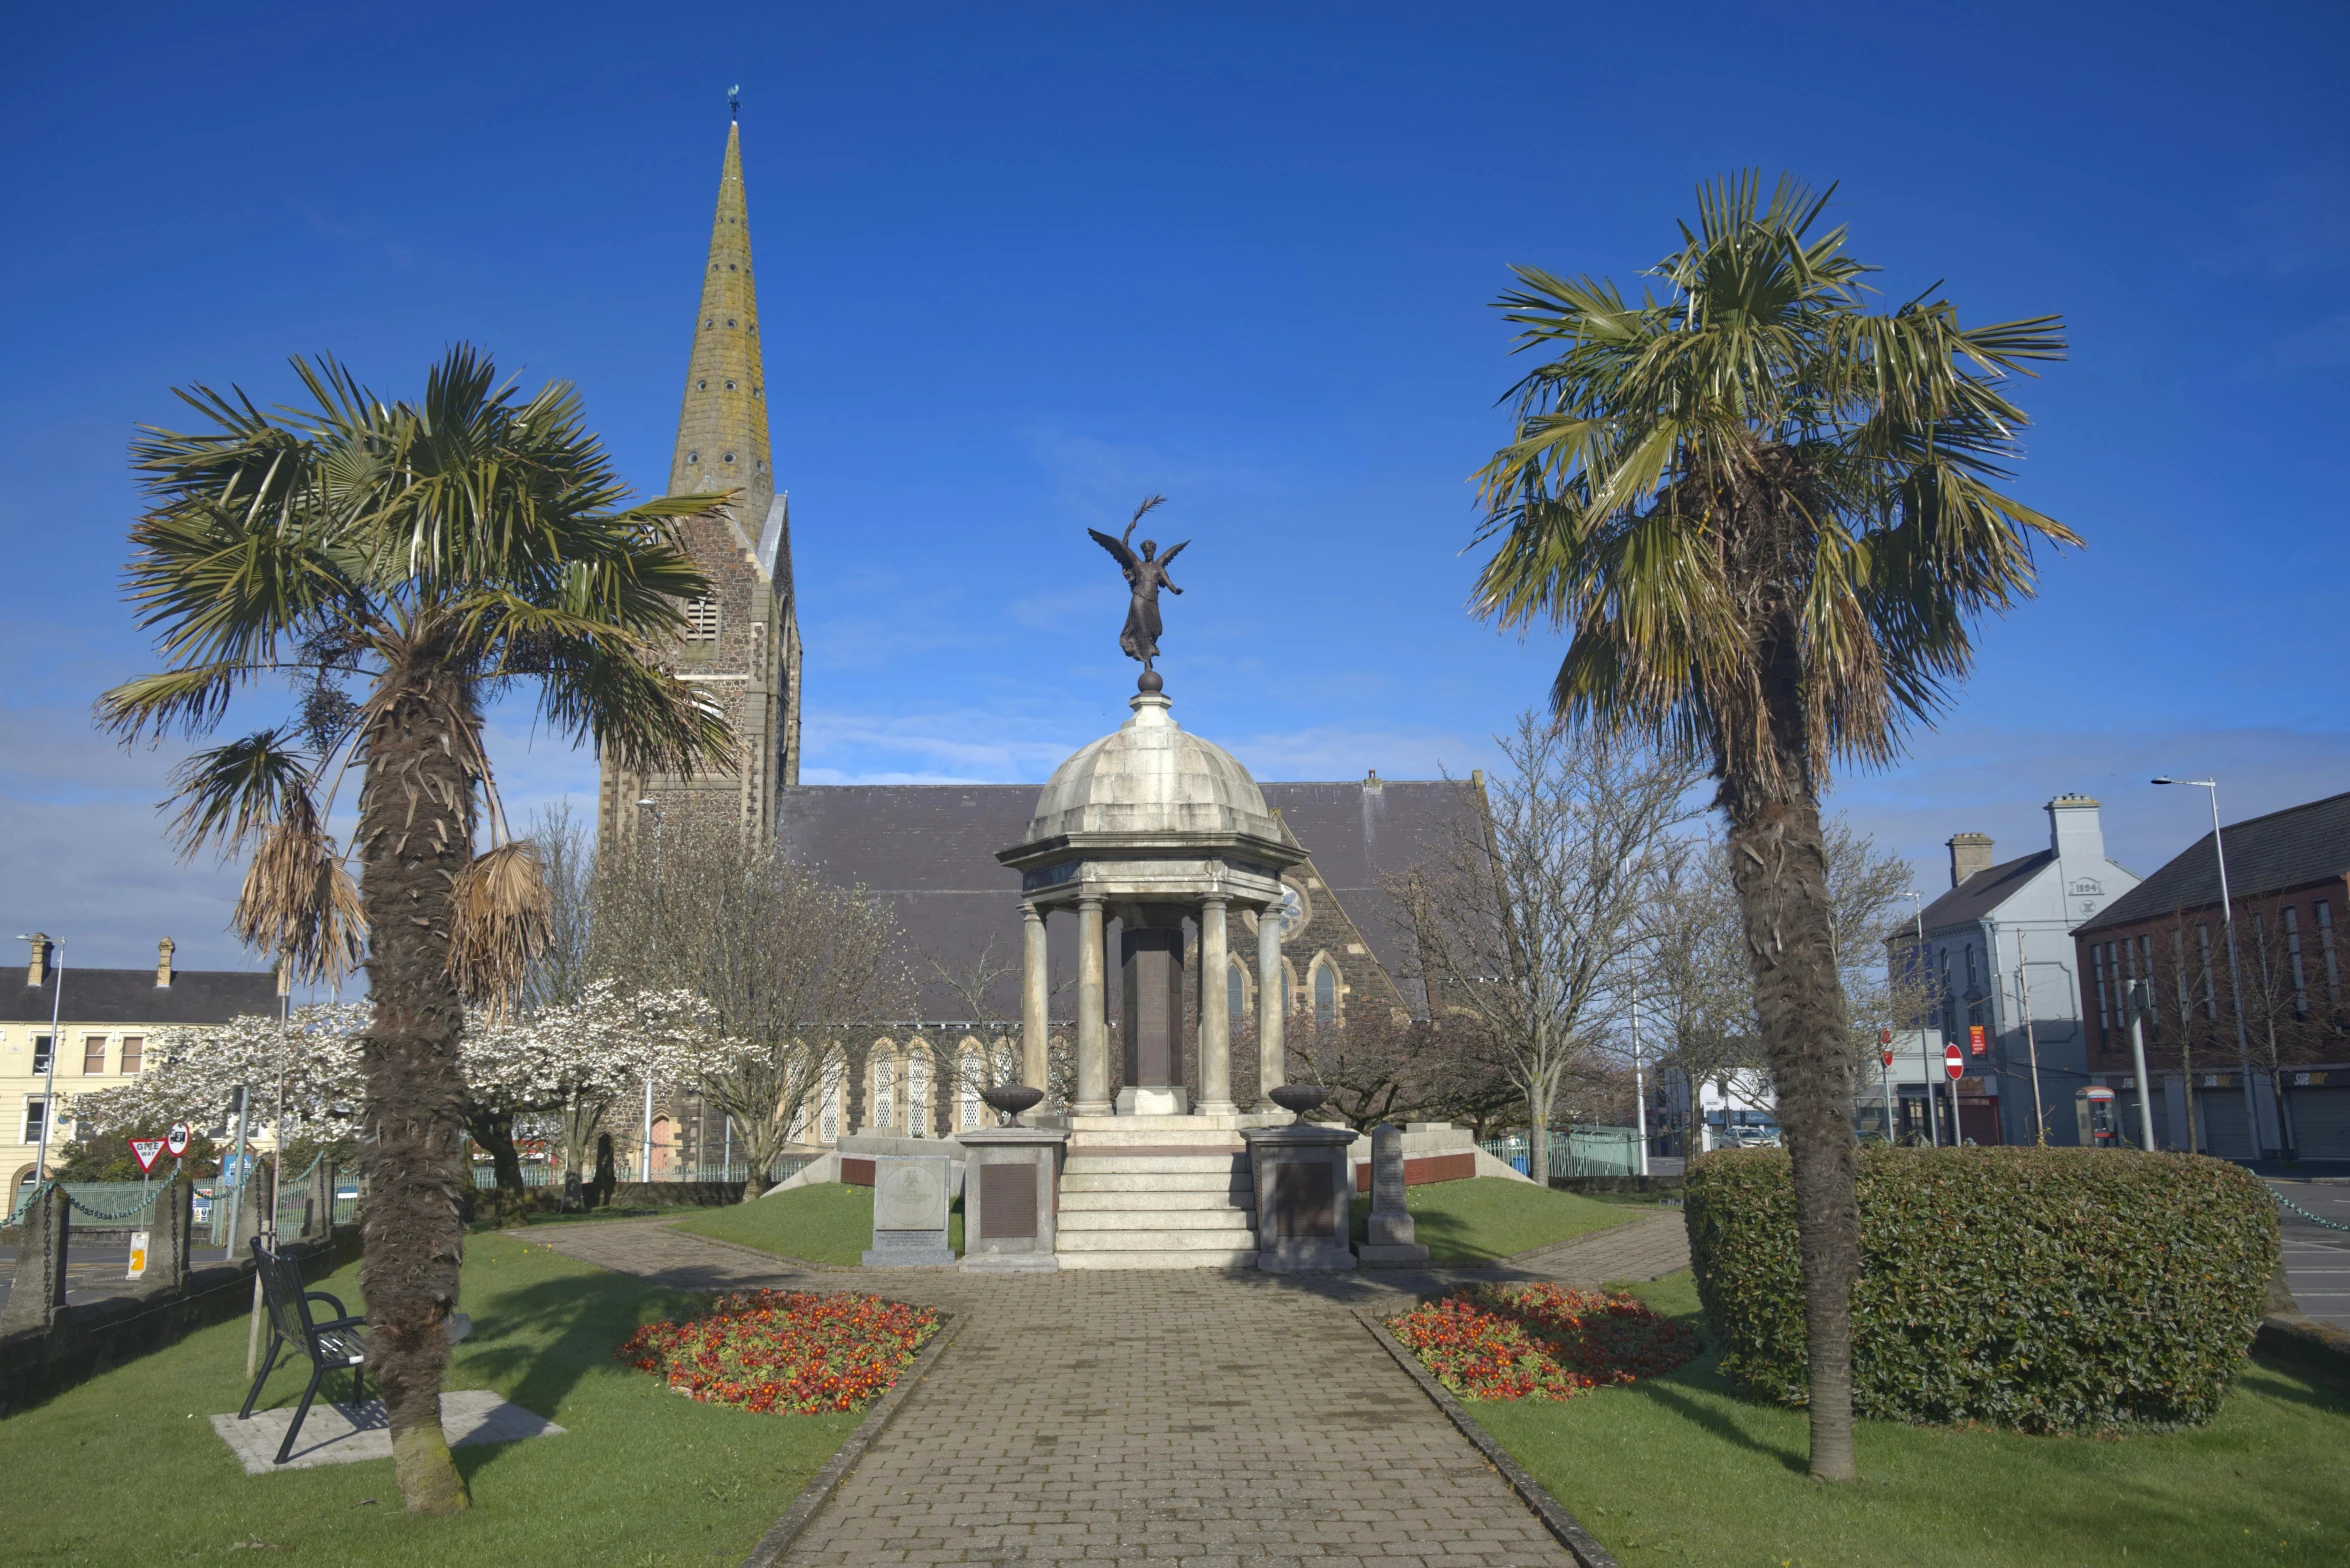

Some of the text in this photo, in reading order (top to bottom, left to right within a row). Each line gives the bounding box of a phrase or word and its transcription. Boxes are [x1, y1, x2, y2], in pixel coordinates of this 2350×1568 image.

[2076, 884, 2097, 892] 1894
[2204, 1075, 2230, 1087] SUBWAY
[2293, 1072, 2329, 1086] SUBWAY
